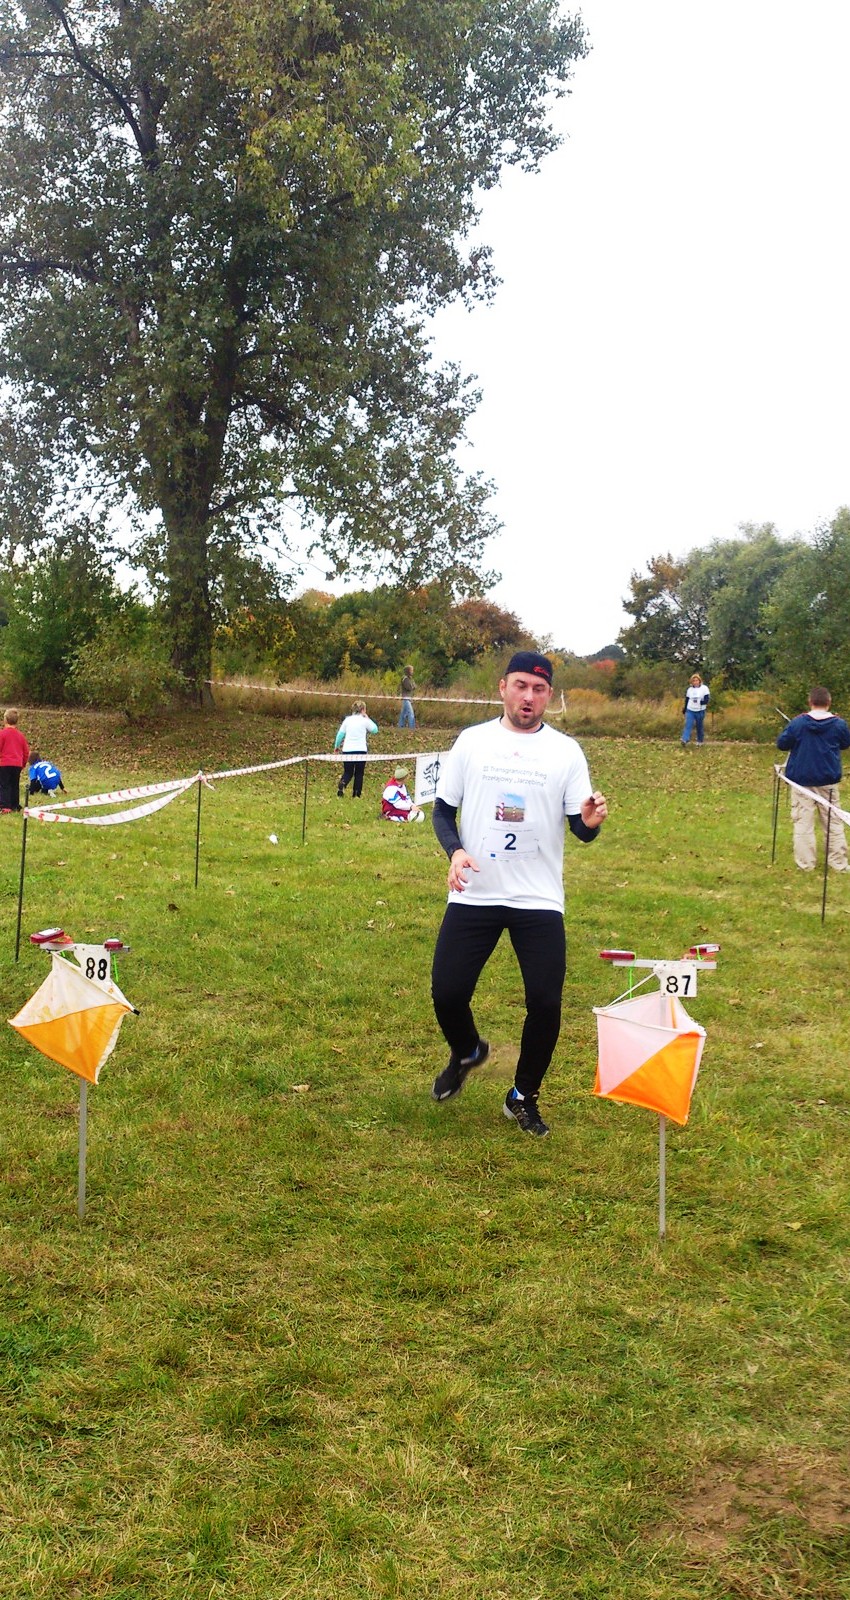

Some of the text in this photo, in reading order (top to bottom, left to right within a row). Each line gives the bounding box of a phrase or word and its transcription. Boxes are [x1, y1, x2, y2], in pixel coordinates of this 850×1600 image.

[39, 762, 57, 779] 2
[504, 832, 517, 851] 2
[85, 956, 108, 981] 88
[665, 974, 692, 996] 87
